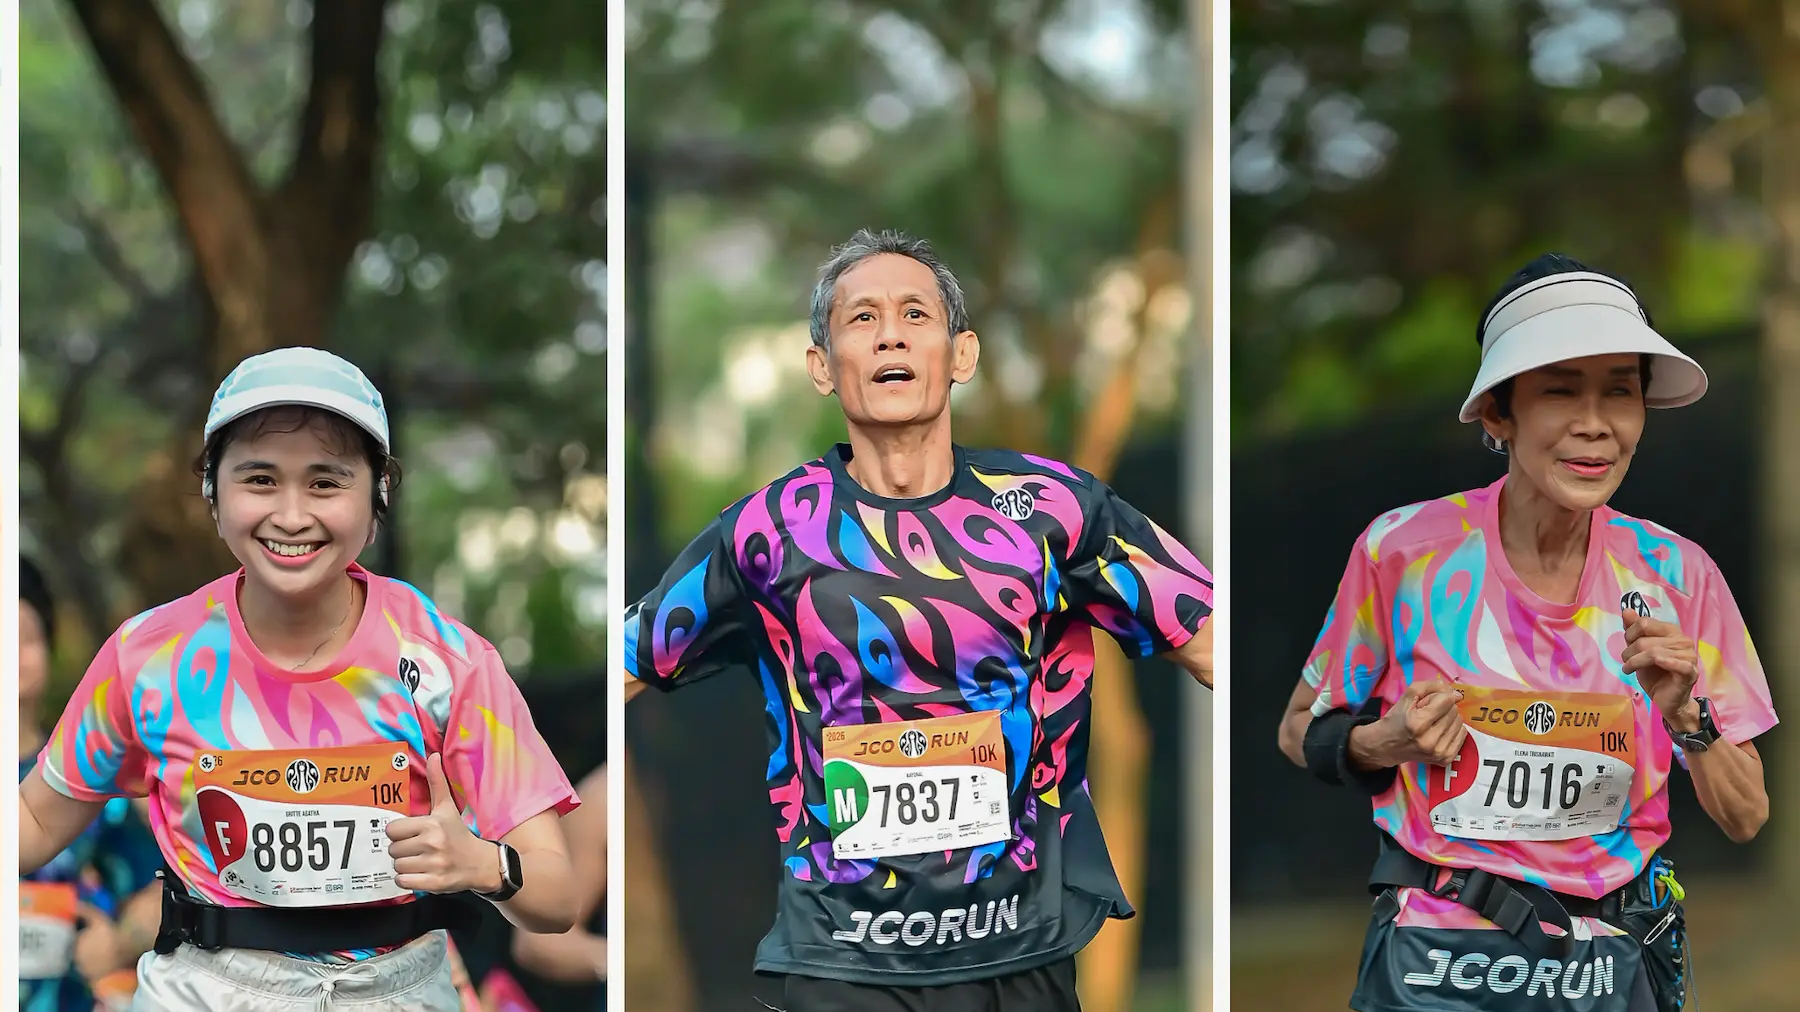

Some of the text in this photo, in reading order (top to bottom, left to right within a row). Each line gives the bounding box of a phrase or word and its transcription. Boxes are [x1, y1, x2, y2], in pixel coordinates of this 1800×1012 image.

[1471, 706, 1600, 728] JCO RUN
[827, 731, 845, 741] 2026
[854, 730, 969, 756] JCO RUN
[970, 744, 998, 764] 10K
[1600, 731, 1628, 753] 10K
[232, 765, 370, 785] JCO RUN
[1443, 754, 1461, 792] F
[1482, 759, 1583, 810] 7016
[370, 782, 403, 806] 10K
[833, 787, 859, 823] M
[872, 777, 960, 828] 7837
[214, 820, 232, 856] F
[252, 819, 356, 872] 8857
[832, 894, 1019, 946] JCORUN
[1403, 949, 1615, 1000] JCORUN
